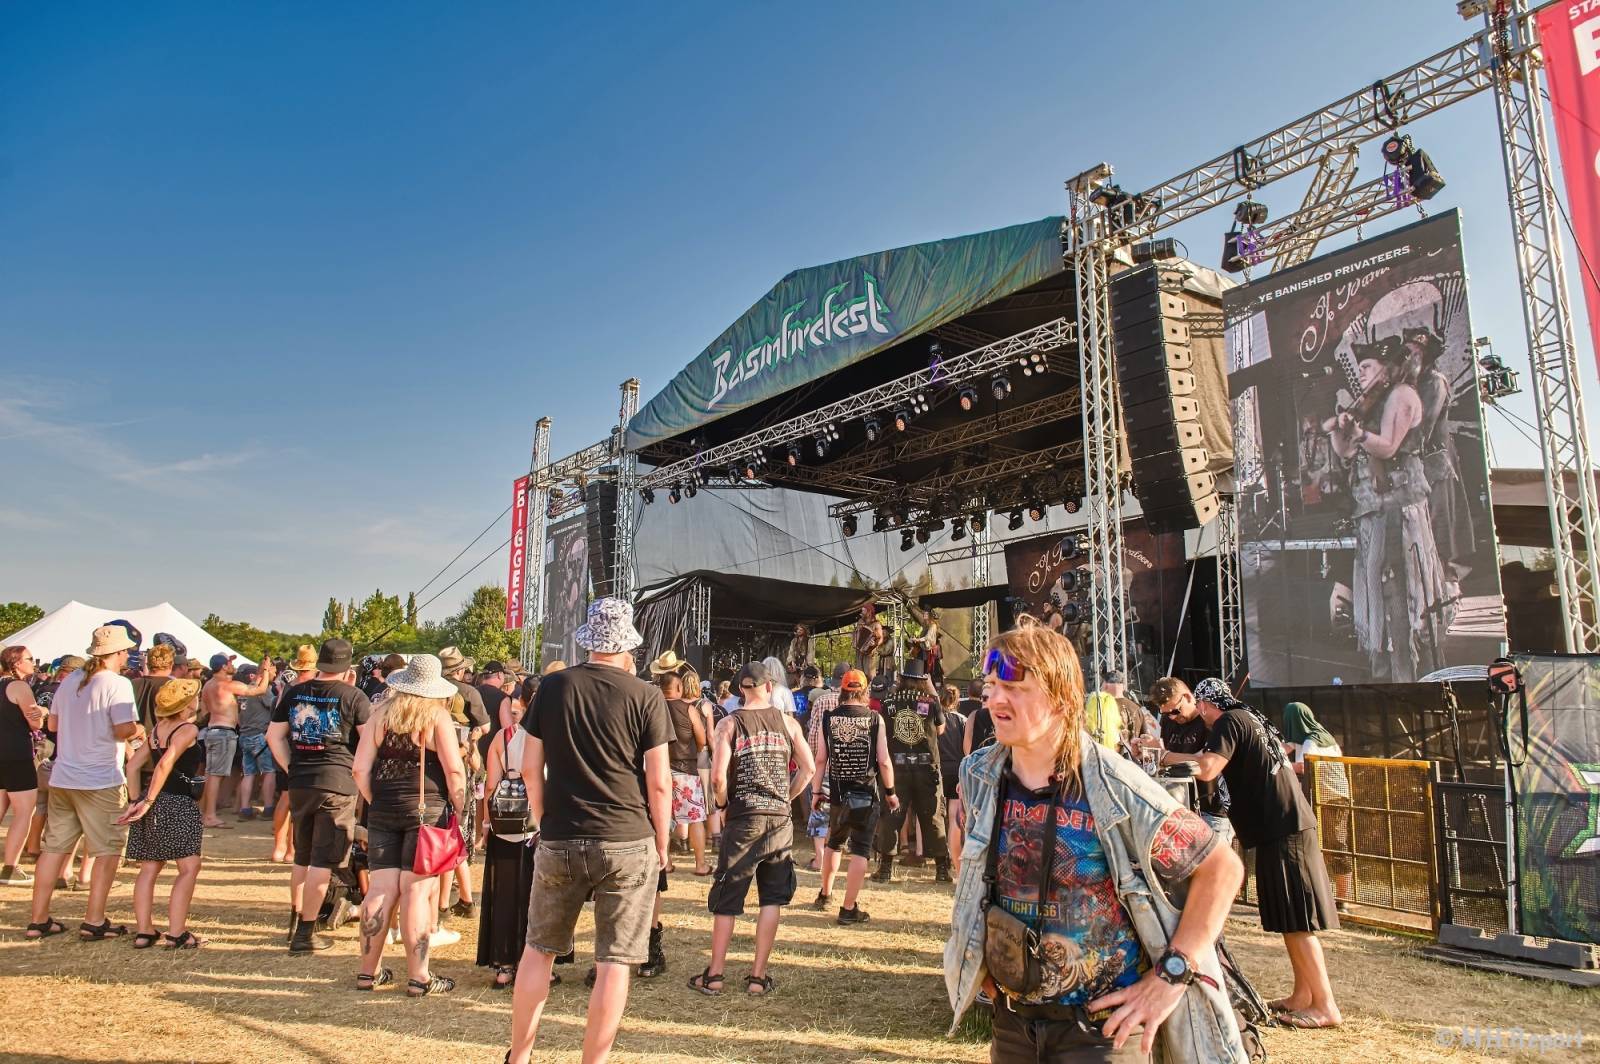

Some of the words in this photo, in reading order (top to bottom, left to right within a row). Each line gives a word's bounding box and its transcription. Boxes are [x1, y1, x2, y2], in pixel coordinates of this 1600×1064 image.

[1258, 293, 1272, 303] YE
[1275, 272, 1332, 297] BANISHED
[1335, 245, 1411, 278] PRIVATEERS
[511, 488, 526, 629] BIGGEST
